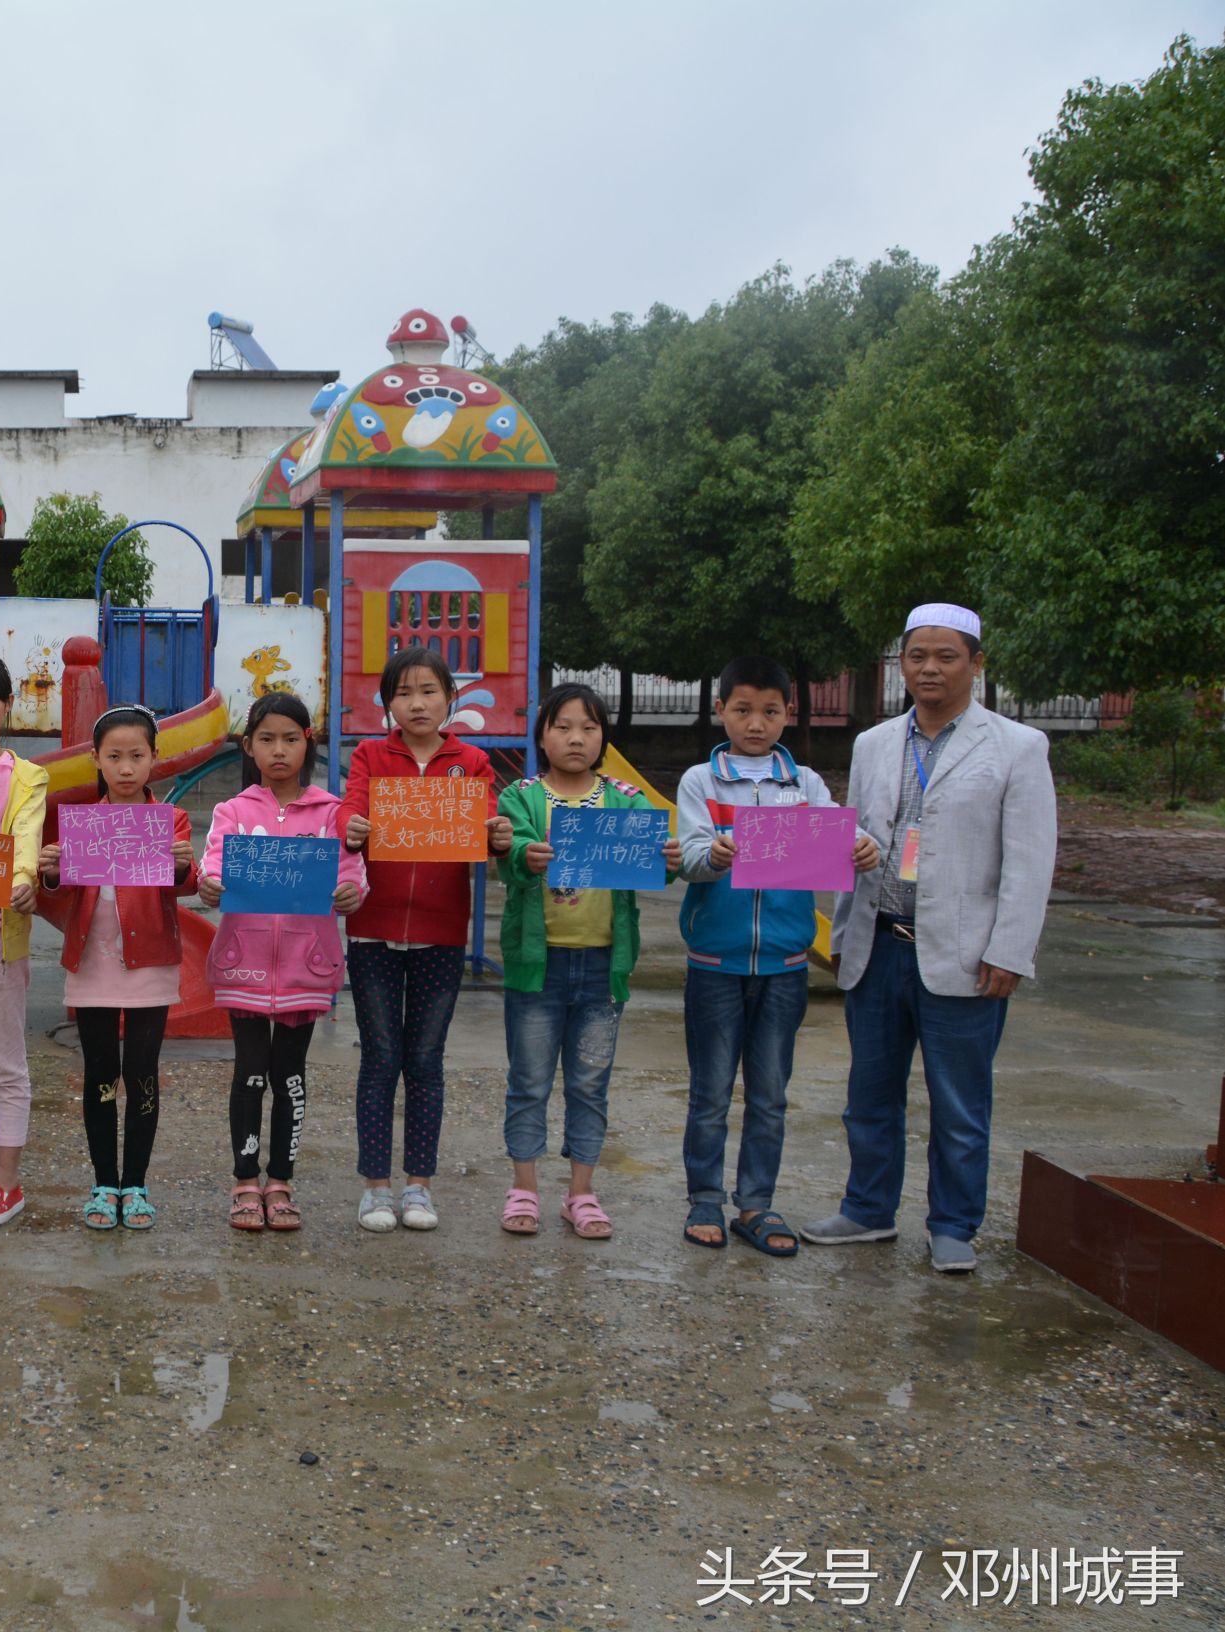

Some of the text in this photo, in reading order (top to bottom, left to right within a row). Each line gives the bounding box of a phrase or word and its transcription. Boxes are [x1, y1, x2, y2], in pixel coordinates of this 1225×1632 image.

[375, 777, 485, 800] 我希望我们的
[374, 797, 475, 821] 学校变得更
[61, 807, 169, 839] 我希望我
[560, 810, 668, 843] 我很想去
[62, 836, 168, 860] 们的学校
[225, 836, 329, 863] 我希望来一位
[557, 837, 655, 869] 花洲书院
[64, 860, 174, 885] 有一个排球
[225, 855, 303, 888] 音乐教师
[558, 864, 594, 888] 看看
